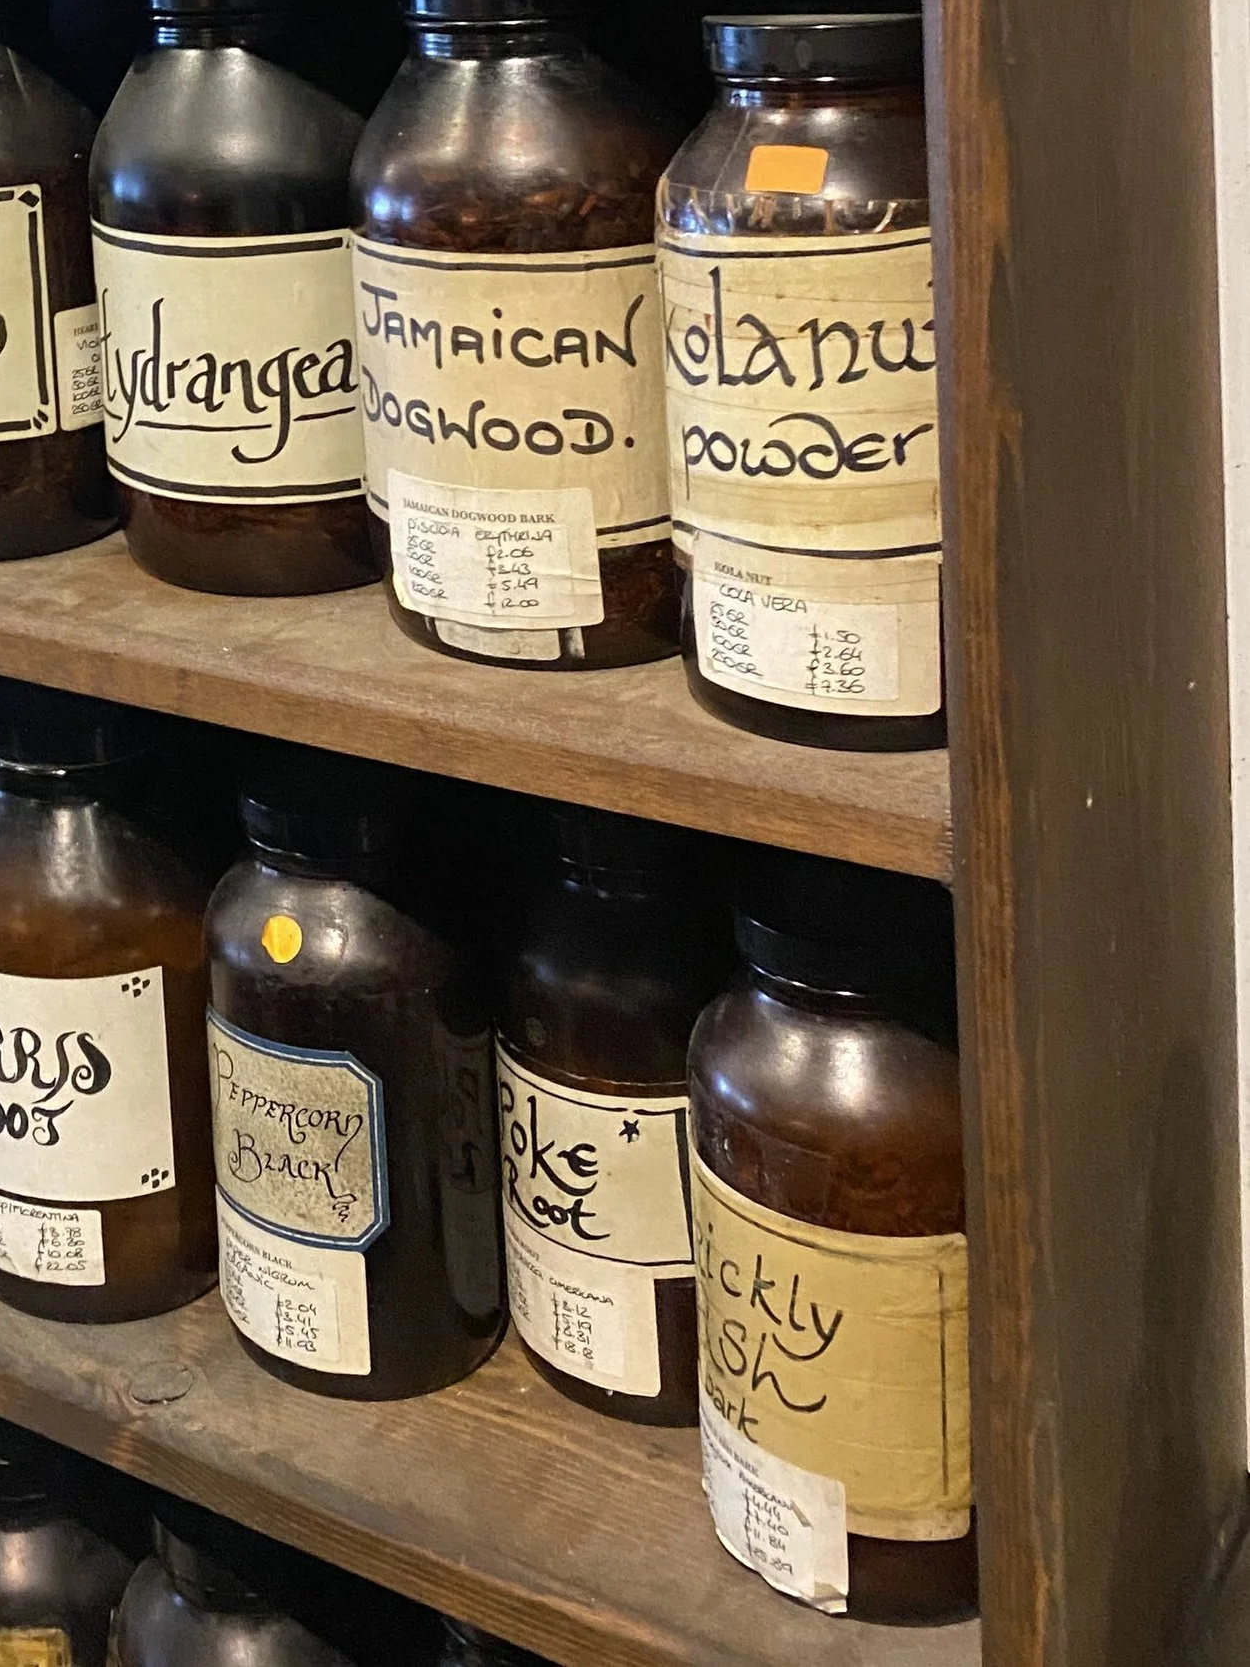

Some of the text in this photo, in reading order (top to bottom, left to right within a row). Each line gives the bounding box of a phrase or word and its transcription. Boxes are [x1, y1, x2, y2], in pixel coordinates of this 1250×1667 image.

[360, 281, 644, 370] JAMAICAN
[361, 365, 636, 457] DOGWOOD.
[681, 412, 935, 502] powder
[403, 497, 556, 524] JAMAICAN DOGWOOD BARK
[713, 561, 773, 585] KOLA NUT
[213, 1043, 364, 1174] PEPPERCORN
[499, 1081, 600, 1197] Poke
[228, 1128, 357, 1202] BLACK
[502, 1154, 611, 1241] Root
[261, 1251, 293, 1268] BLACK
